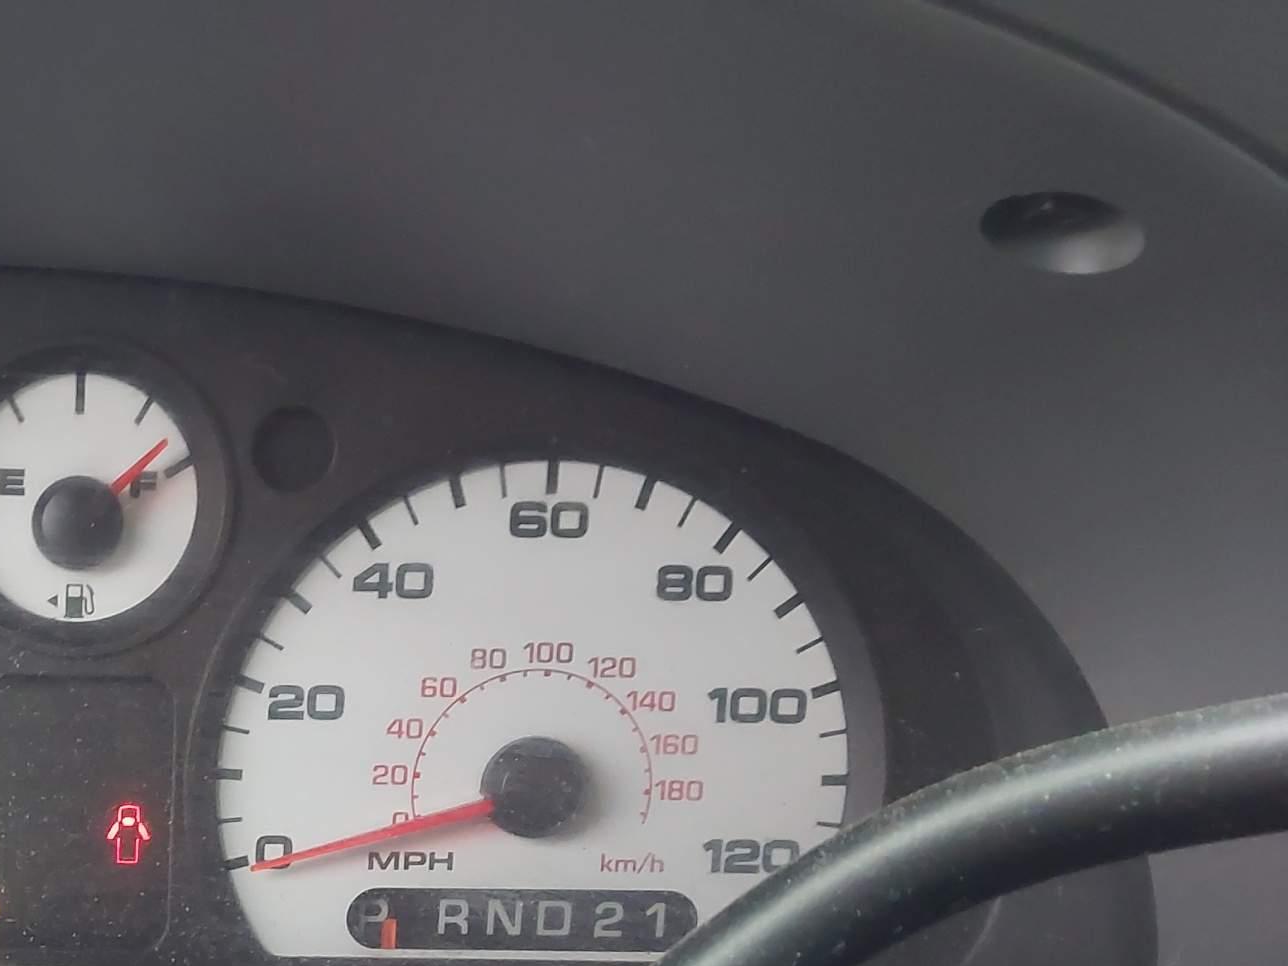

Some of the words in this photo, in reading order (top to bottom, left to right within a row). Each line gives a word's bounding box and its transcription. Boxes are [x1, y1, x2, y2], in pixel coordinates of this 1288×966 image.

[130, 471, 158, 498] F
[510, 501, 588, 538] 60
[353, 563, 434, 599] 40
[656, 565, 733, 602] 80
[470, 648, 507, 669] 80
[523, 642, 574, 664] 100
[587, 657, 636, 679] 120
[420, 677, 457, 699] 60
[267, 685, 345, 720] 20
[627, 690, 676, 713] 140
[707, 688, 808, 725] 100
[386, 719, 423, 740] 40
[650, 735, 698, 756] 160
[372, 765, 408, 786] 20
[655, 780, 704, 802] 180
[256, 835, 293, 869] 0
[368, 852, 454, 871] MPH
[601, 853, 664, 873] km/h
[703, 839, 800, 873] 120
[359, 900, 388, 934] P
[438, 899, 469, 935] R
[486, 899, 524, 936] N
[537, 901, 572, 936] D
[593, 903, 623, 938] 2
[646, 903, 666, 937] 1
